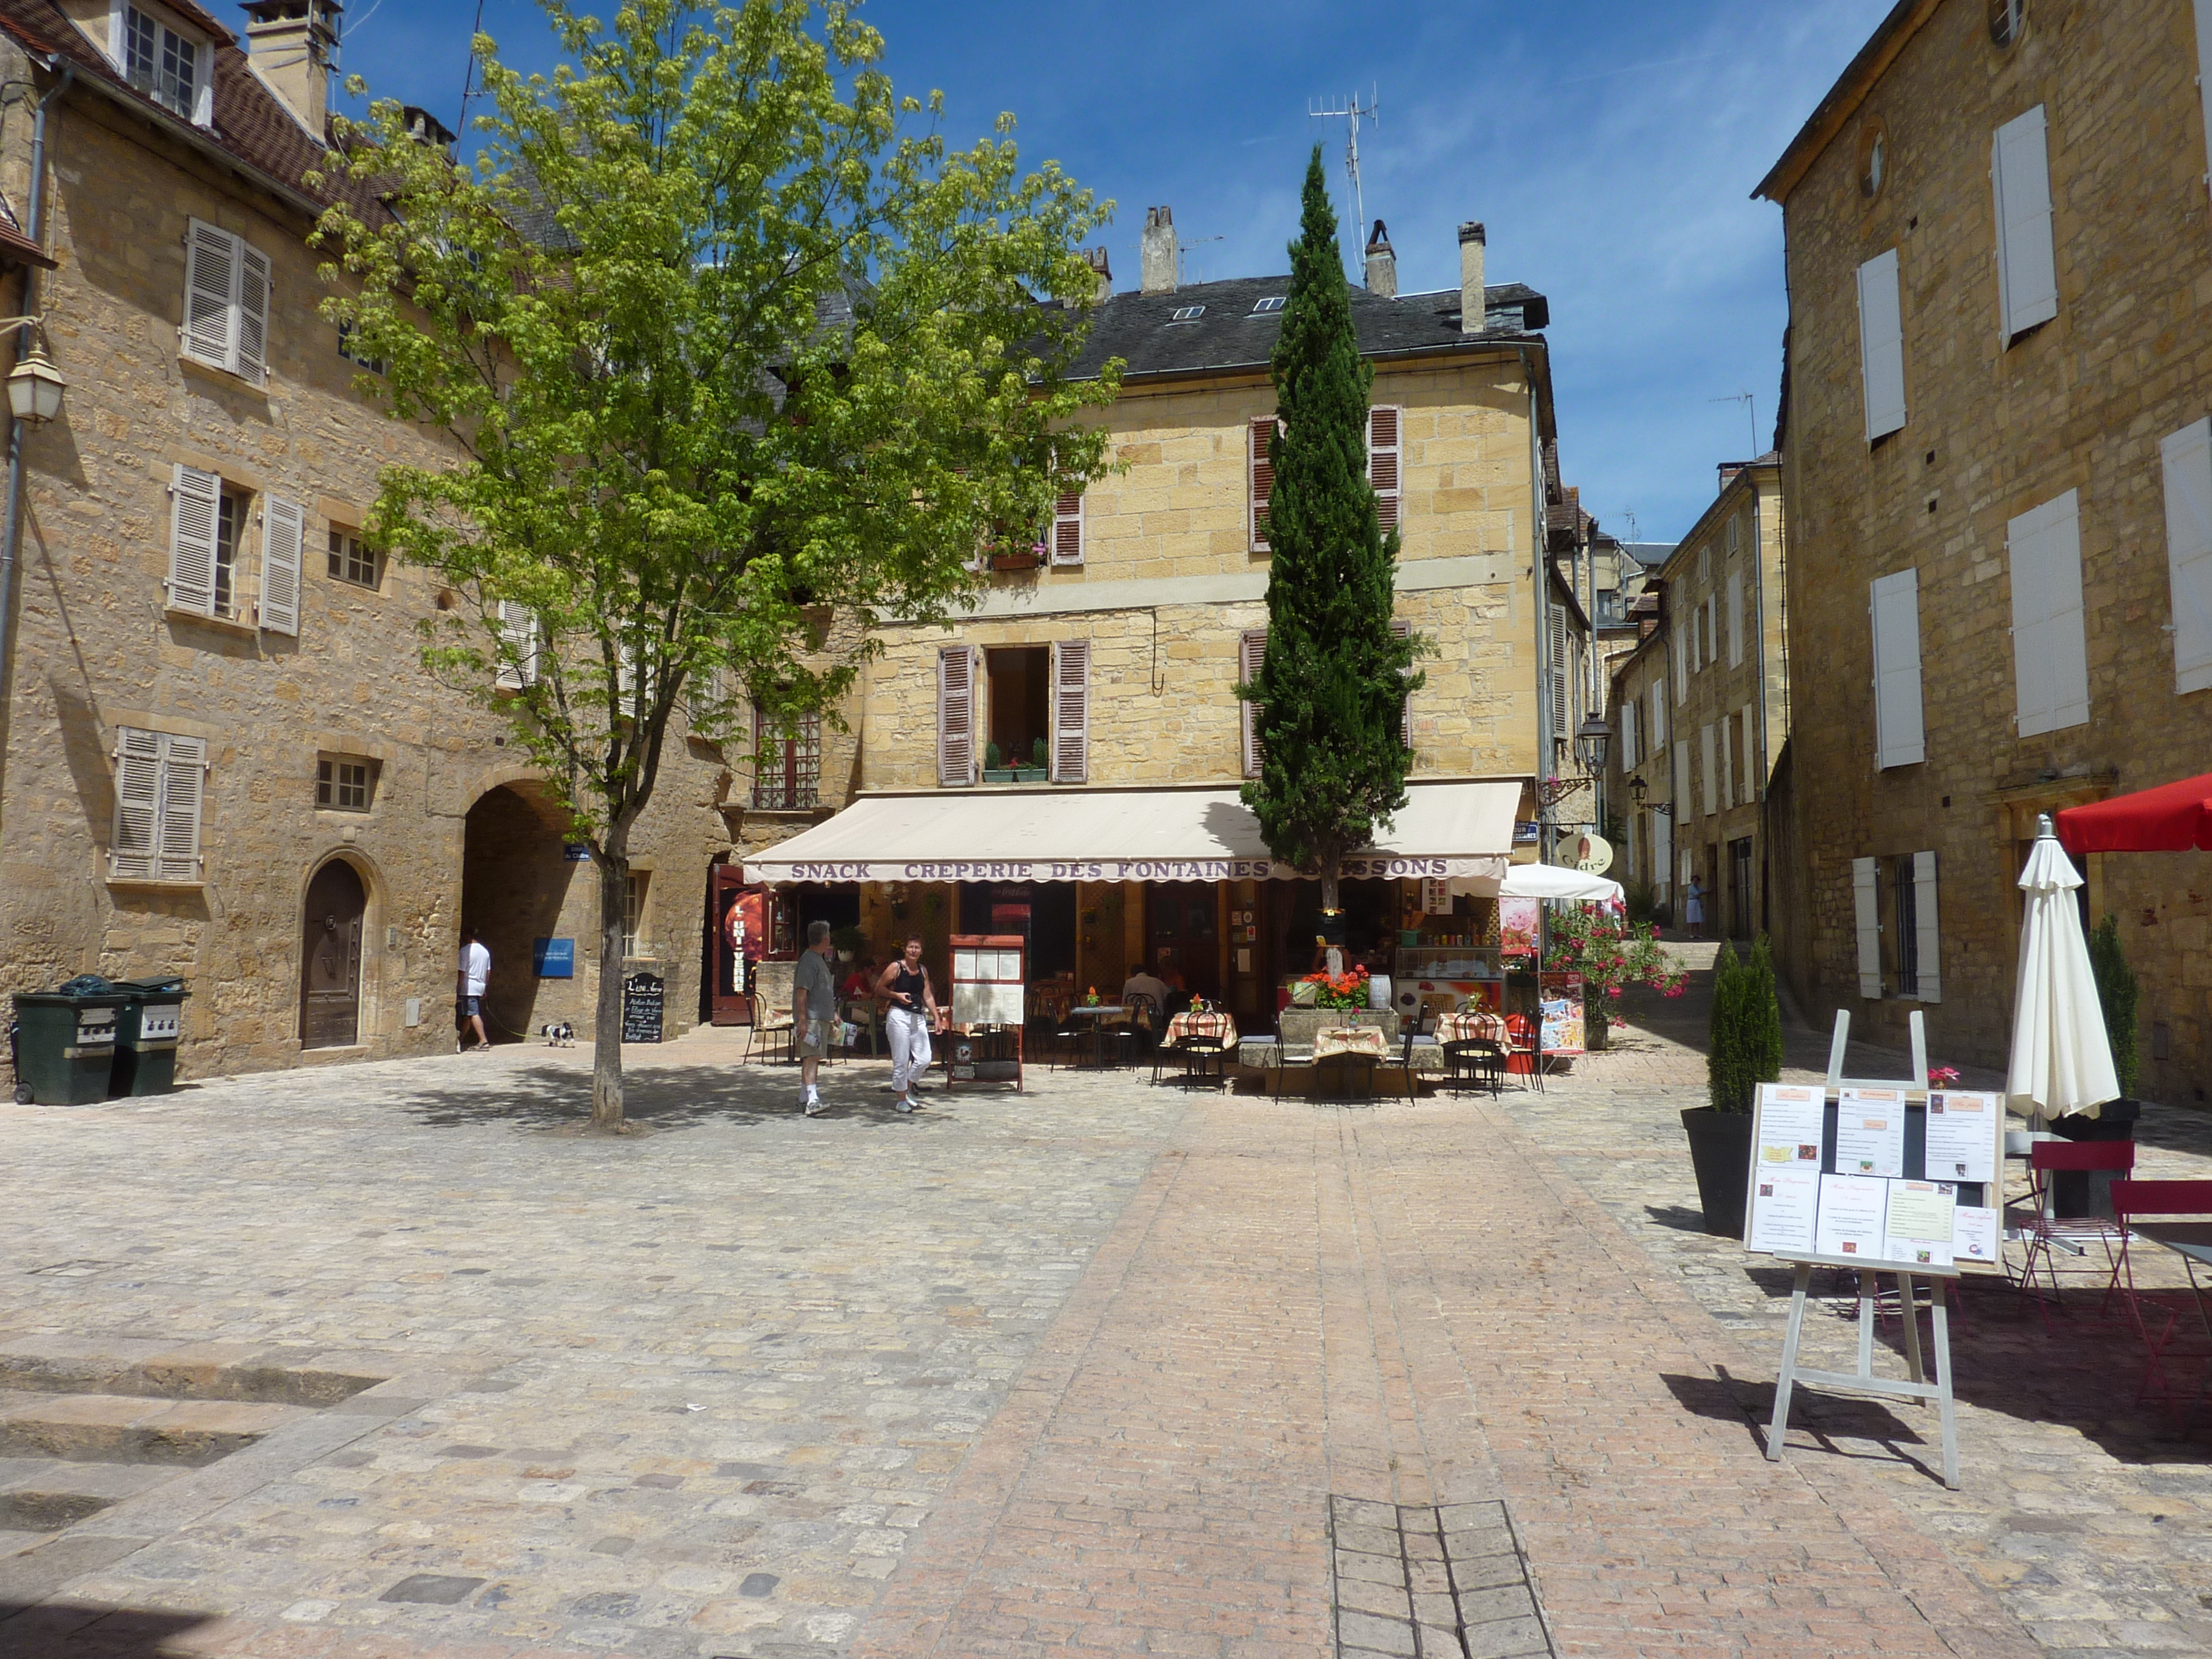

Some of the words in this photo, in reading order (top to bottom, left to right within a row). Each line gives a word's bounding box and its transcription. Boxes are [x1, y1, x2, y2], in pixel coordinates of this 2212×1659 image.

[792, 864, 870, 878] SNACK
[905, 863, 1032, 877] CREPERIE
[1051, 863, 1102, 878] DES
[1117, 862, 1269, 877] FONTAINES
[1562, 854, 1605, 871] Cidre
